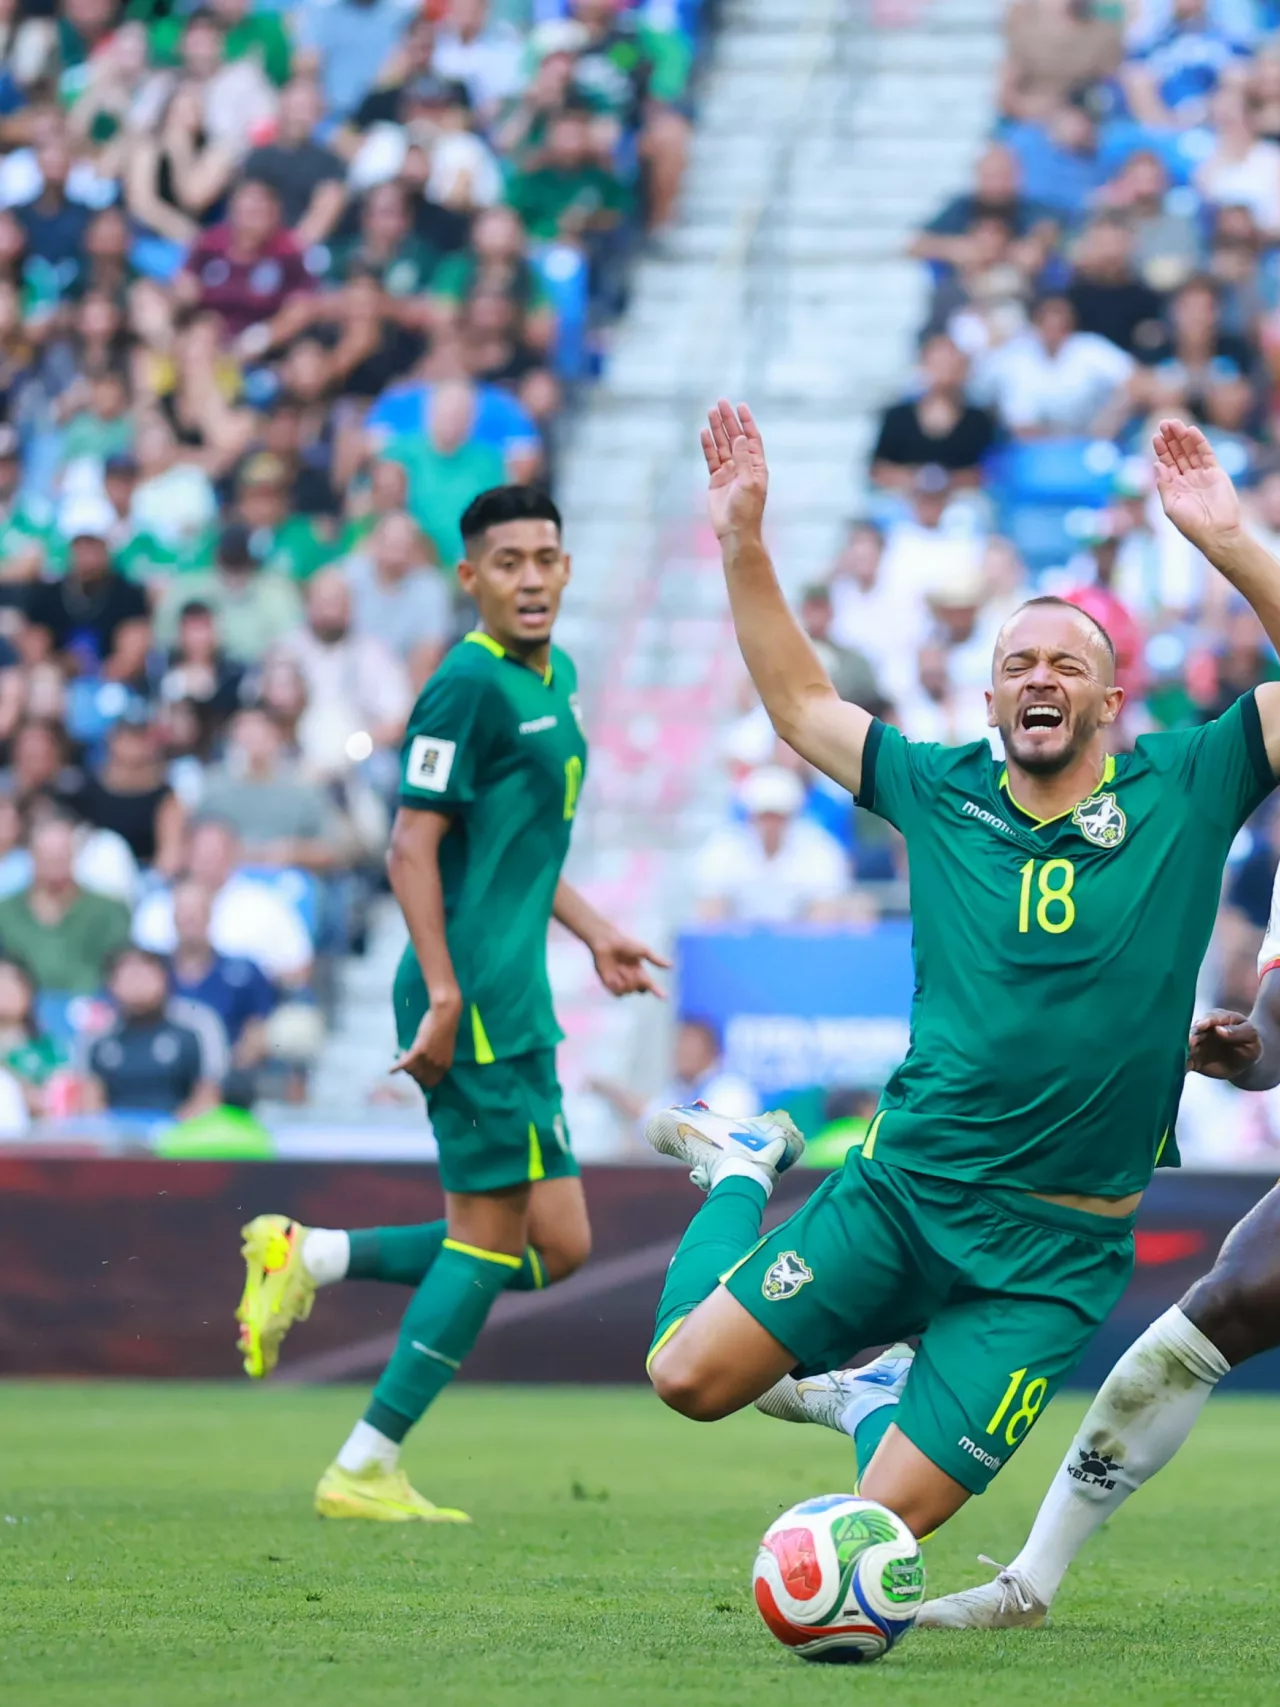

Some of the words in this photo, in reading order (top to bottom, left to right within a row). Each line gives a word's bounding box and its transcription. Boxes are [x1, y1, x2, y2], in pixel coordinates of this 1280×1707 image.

[1018, 858, 1076, 935] 18
[985, 1367, 1049, 1446] 18
[1066, 1463, 1117, 1490] KELME
